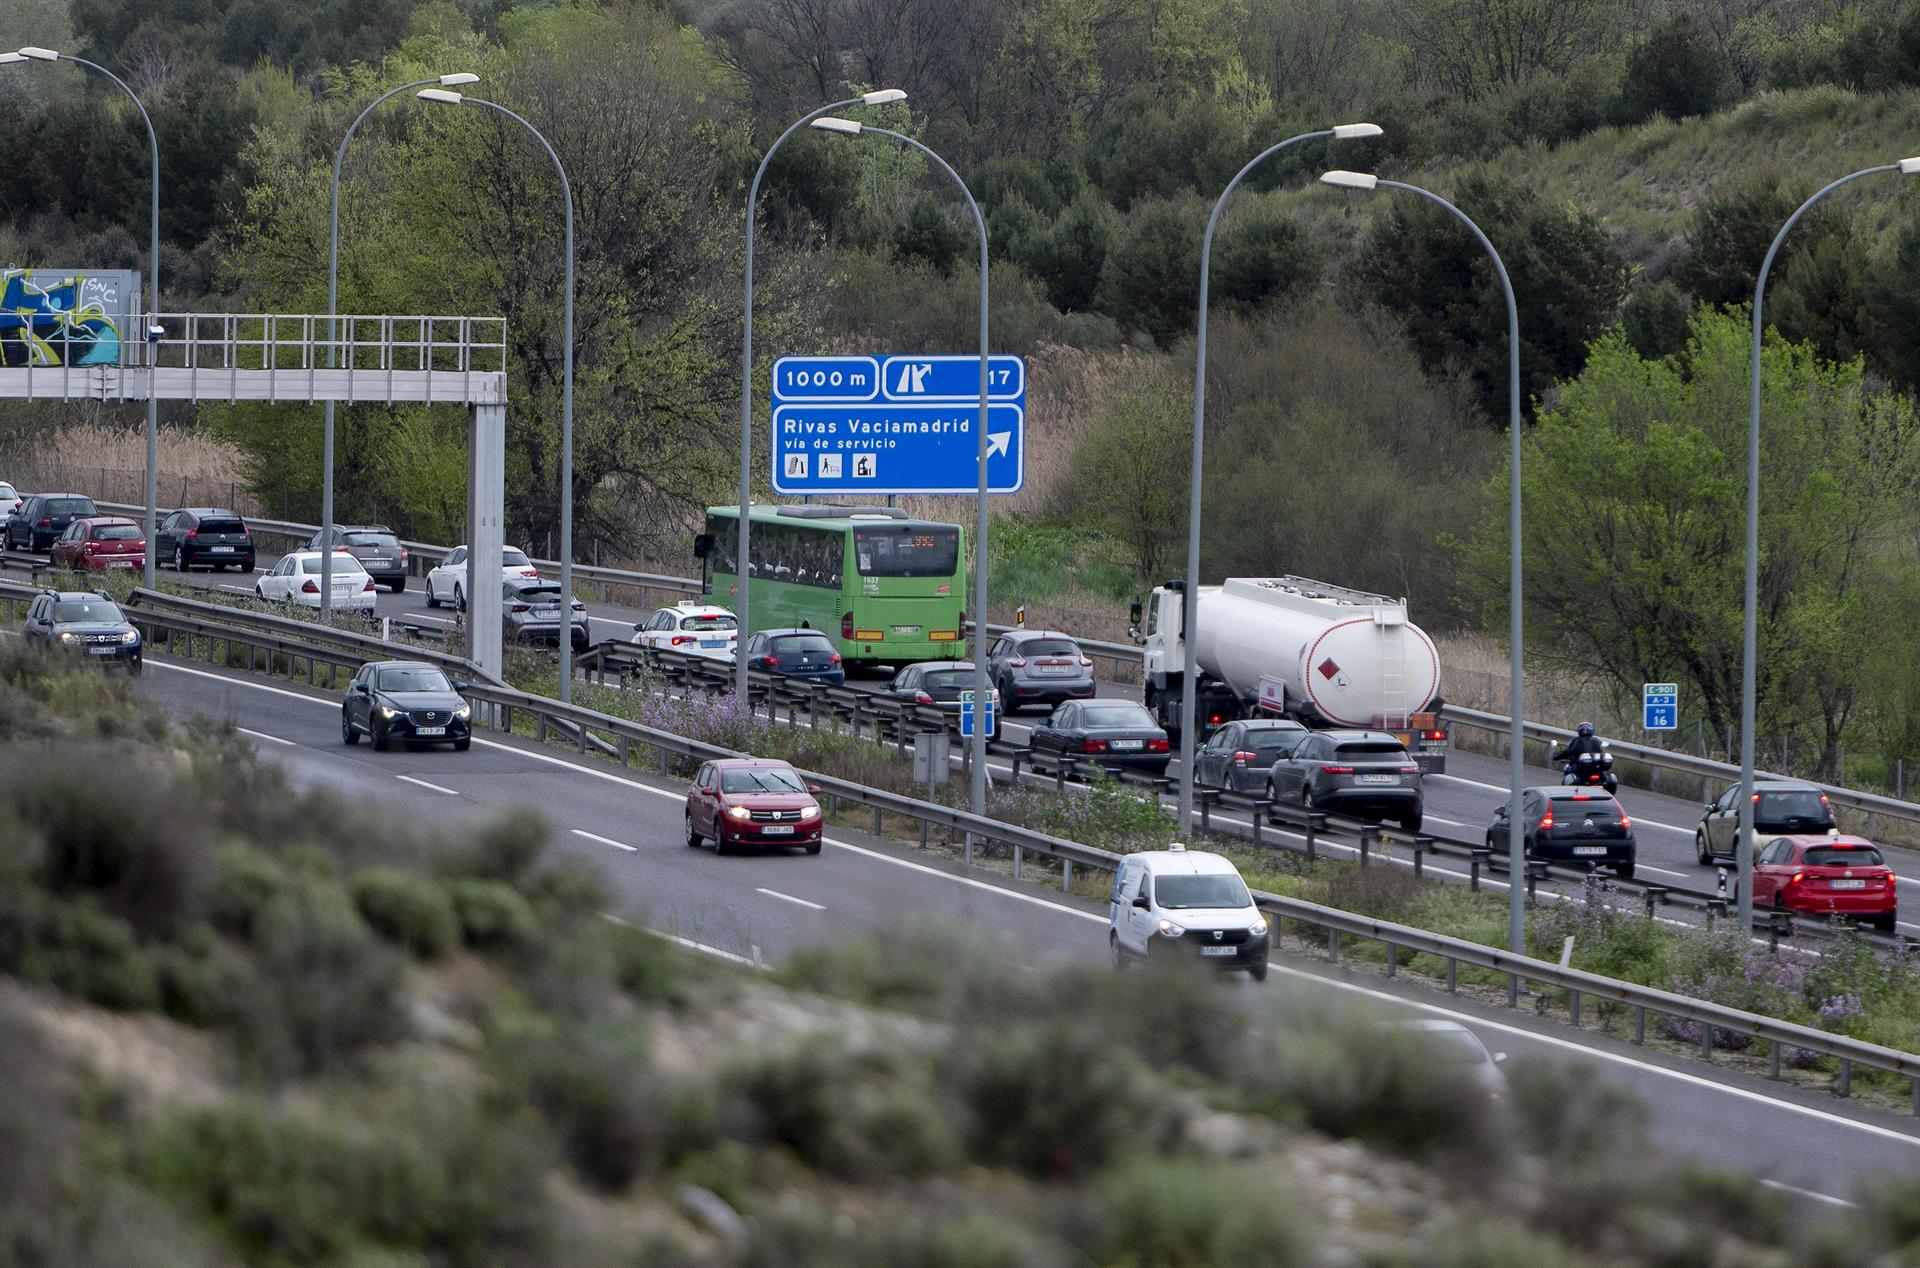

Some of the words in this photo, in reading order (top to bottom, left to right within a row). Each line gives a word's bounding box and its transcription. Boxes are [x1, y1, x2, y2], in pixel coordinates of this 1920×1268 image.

[787, 371, 843, 387] 1000
[850, 374, 866, 386] m
[989, 370, 1010, 385] 17
[784, 419, 837, 433] Rivas
[848, 419, 970, 433] Vaciamadrid
[785, 438, 806, 449] vía
[814, 438, 829, 449] de
[837, 438, 897, 449] servicio
[1648, 686, 1673, 694] E-901
[1652, 696, 1670, 704] A-3
[1654, 716, 1668, 726] 16
